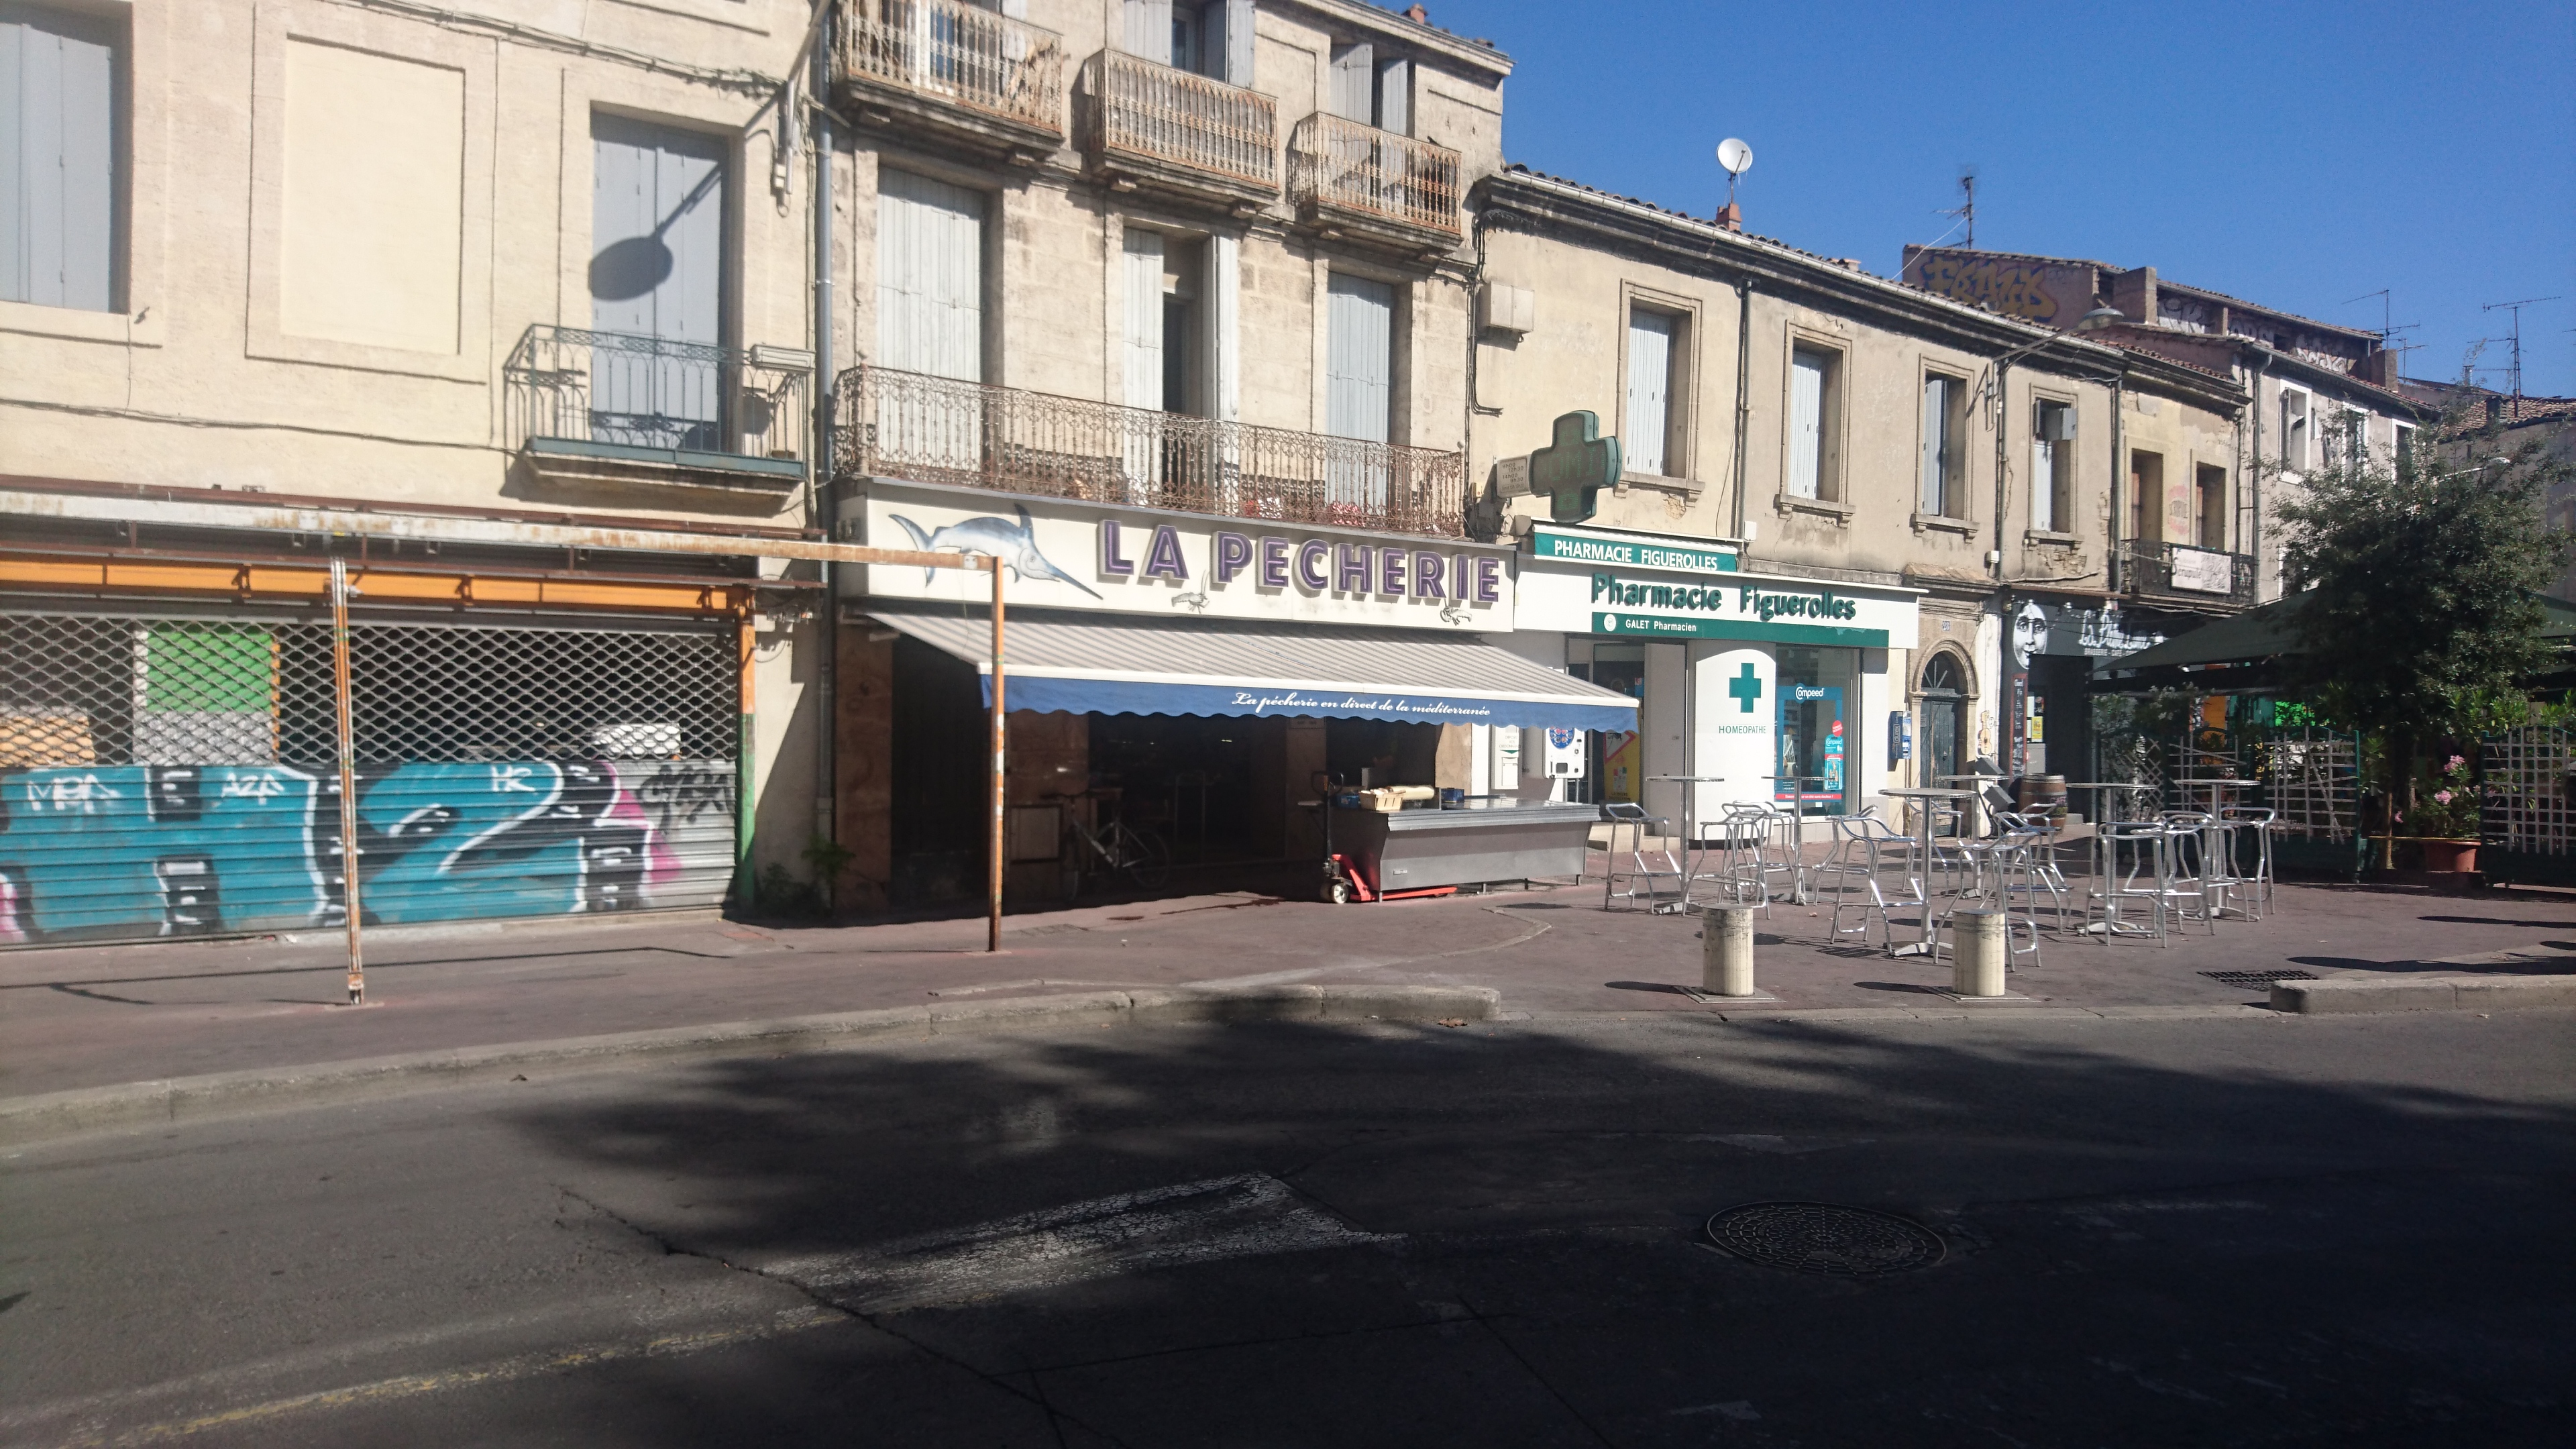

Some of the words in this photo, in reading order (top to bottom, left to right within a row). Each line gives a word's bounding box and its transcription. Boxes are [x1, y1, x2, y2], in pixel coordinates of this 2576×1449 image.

[1099, 519, 1189, 580] LA
[1212, 531, 1499, 602] PECHERIE
[1554, 540, 1632, 563] PHARMACIE
[1641, 549, 1717, 571] FIGUEROLLES
[1591, 573, 1722, 611] Pharmacie
[1739, 584, 1857, 622] Figuerolles
[1625, 619, 1650, 630] GALET
[1654, 621, 1697, 633] Pharmacien
[1232, 692, 1256, 705] La
[1255, 692, 1318, 713] pécherie
[1340, 697, 1377, 710] direct
[1379, 699, 1393, 711] de
[1395, 700, 1409, 712] la
[1411, 702, 1491, 716] méditerranée
[1796, 686, 1823, 700] Compeed
[1719, 725, 1766, 734] HOMEOPATHIE
